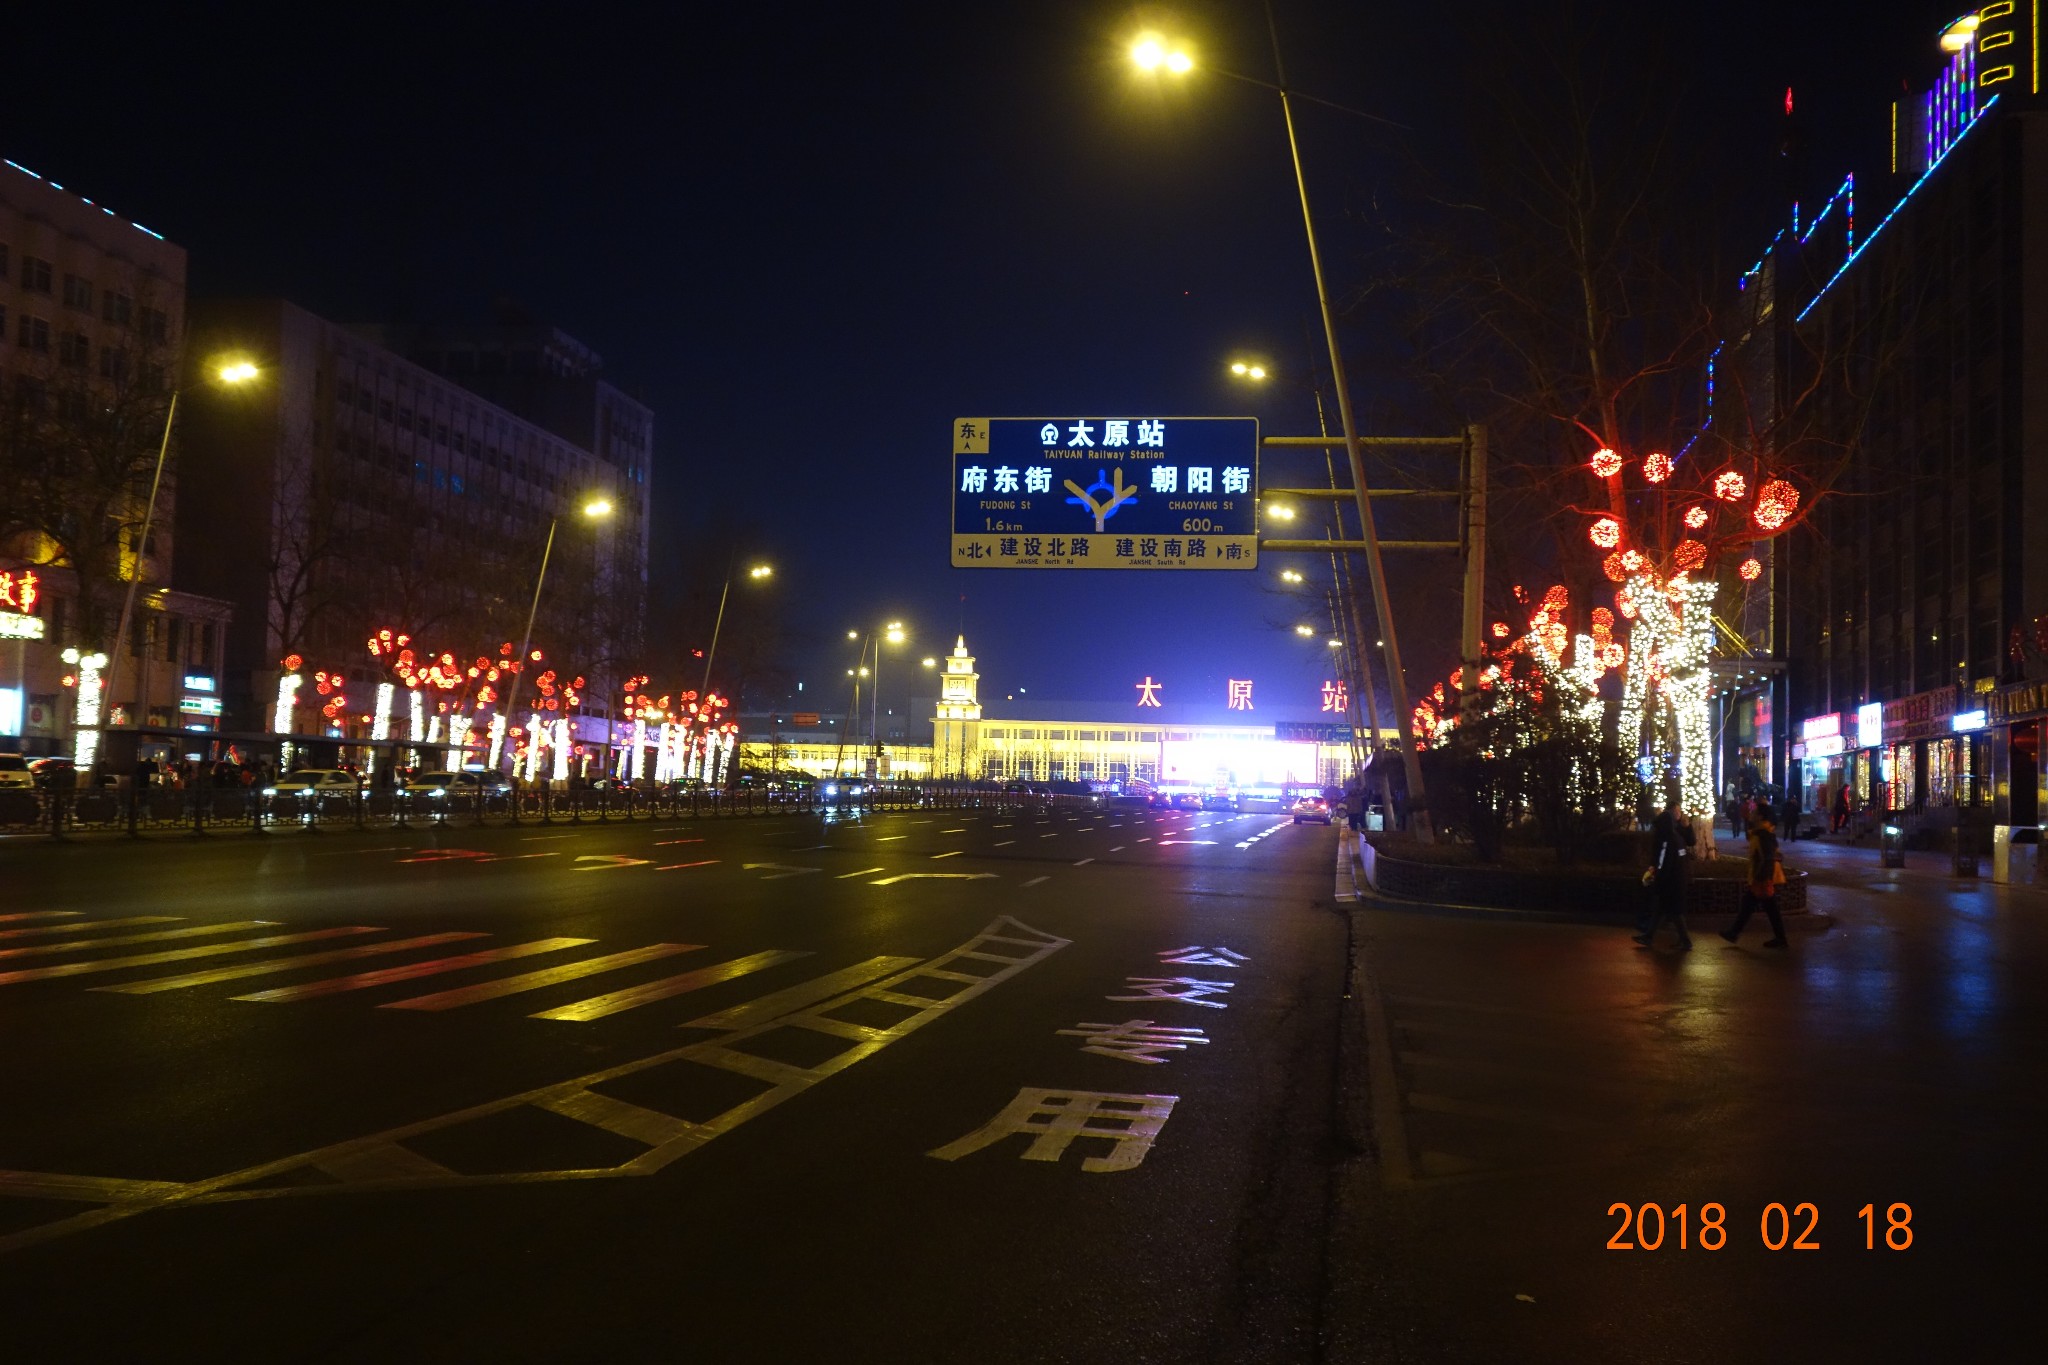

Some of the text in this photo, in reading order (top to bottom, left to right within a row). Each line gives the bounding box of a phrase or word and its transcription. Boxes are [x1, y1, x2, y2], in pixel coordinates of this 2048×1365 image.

[961, 423, 976, 439] 东
[980, 431, 986, 439] E
[1067, 419, 1165, 447] 太原站
[1044, 450, 1165, 461] TAIYUAN Railway Station
[961, 465, 1053, 494] 府东街
[1150, 465, 1250, 494] 朝阳街
[980, 500, 1031, 510] FUDONG St
[1168, 501, 1234, 510] CHAOYANG St
[958, 542, 983, 559] N 北
[1000, 537, 1090, 557] 建设北路
[1115, 538, 1207, 558] 建设南路
[1225, 543, 1242, 560] 南
[1135, 676, 1348, 712] 太原站
